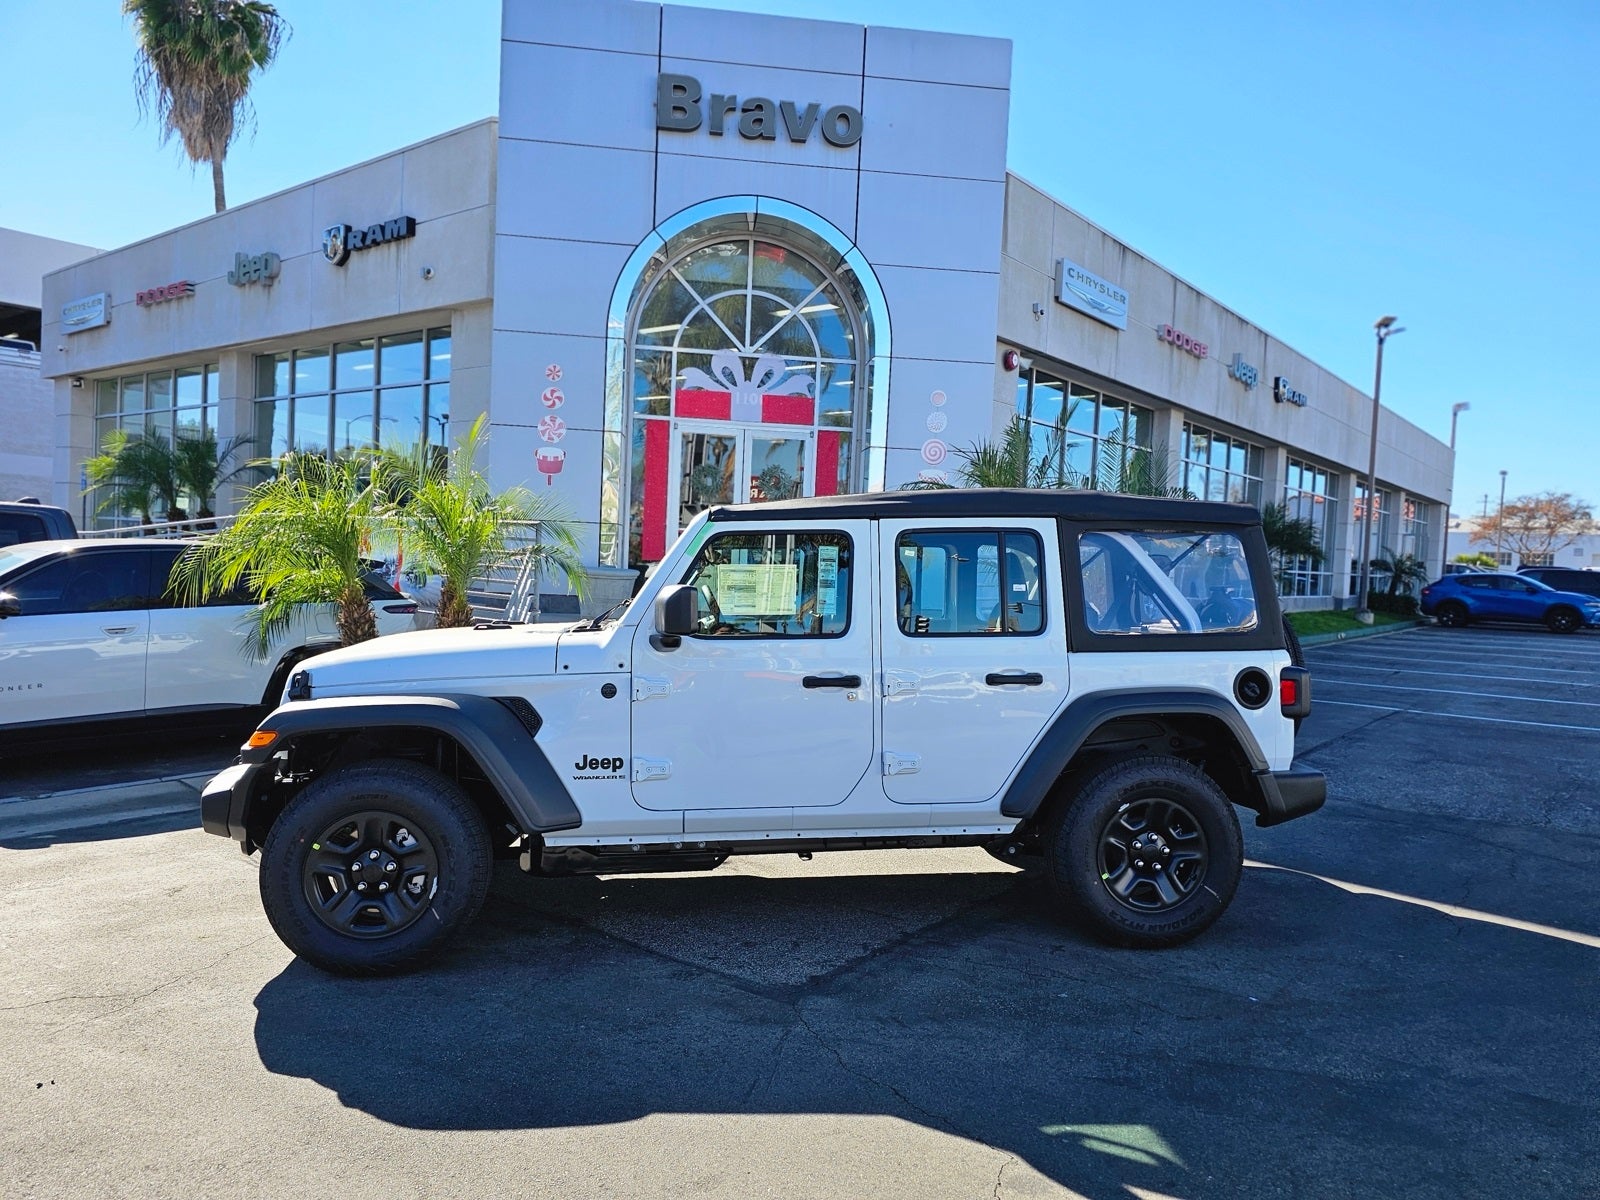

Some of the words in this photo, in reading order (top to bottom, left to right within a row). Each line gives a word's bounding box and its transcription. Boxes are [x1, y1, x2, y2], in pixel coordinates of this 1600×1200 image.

[657, 72, 863, 148] Bravo
[348, 215, 416, 251] RAM
[228, 252, 281, 287] Jeep
[1067, 267, 1126, 304] CHRYSLER
[63, 298, 103, 316] CHRYSLER
[136, 280, 194, 307] DODGE
[1158, 324, 1208, 359] DODGE
[1229, 353, 1258, 391] Jeep
[575, 754, 624, 772] Jeep
